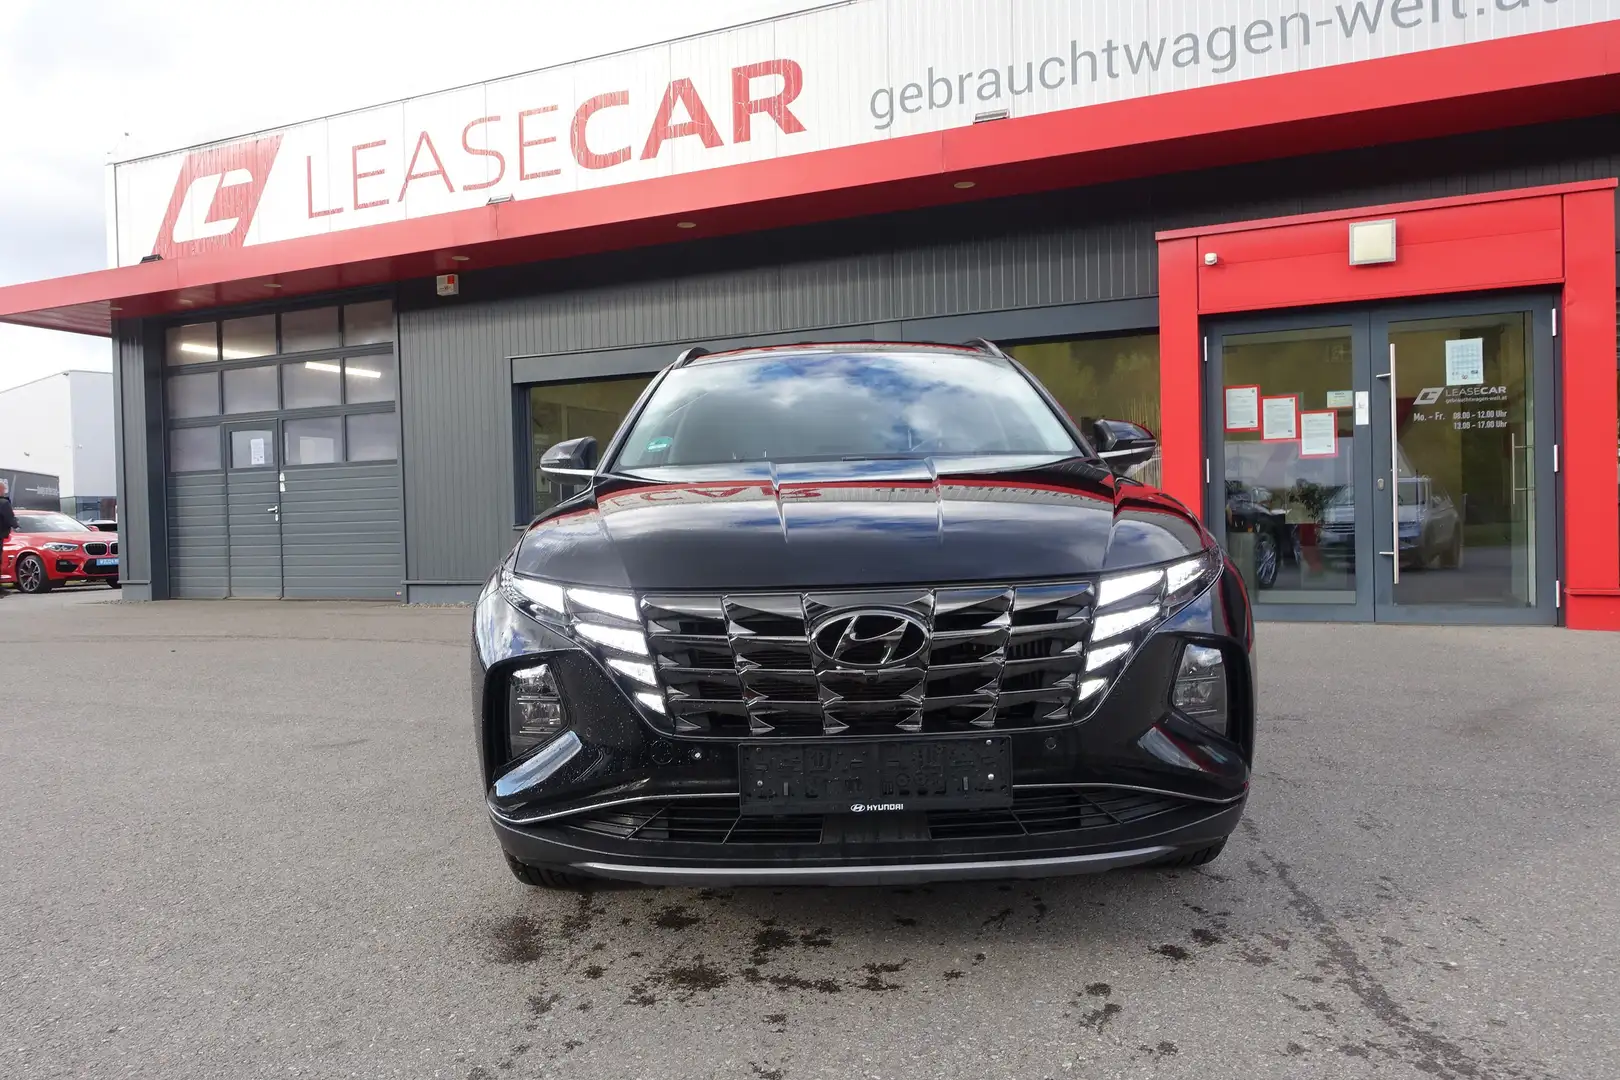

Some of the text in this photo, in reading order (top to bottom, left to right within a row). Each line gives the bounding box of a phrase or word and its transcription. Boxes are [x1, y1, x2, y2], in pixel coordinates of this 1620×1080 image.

[870, 0, 1559, 130] gebrauchtwagen-we.
[306, 58, 807, 219] LEASECAR
[1446, 386, 1507, 396] LEASECAR
[1413, 413, 1427, 421] Mo.
[1435, 411, 1446, 420] Fr.
[1495, 410, 1507, 418] Uhr
[866, 803, 904, 811] HYUNDAI
